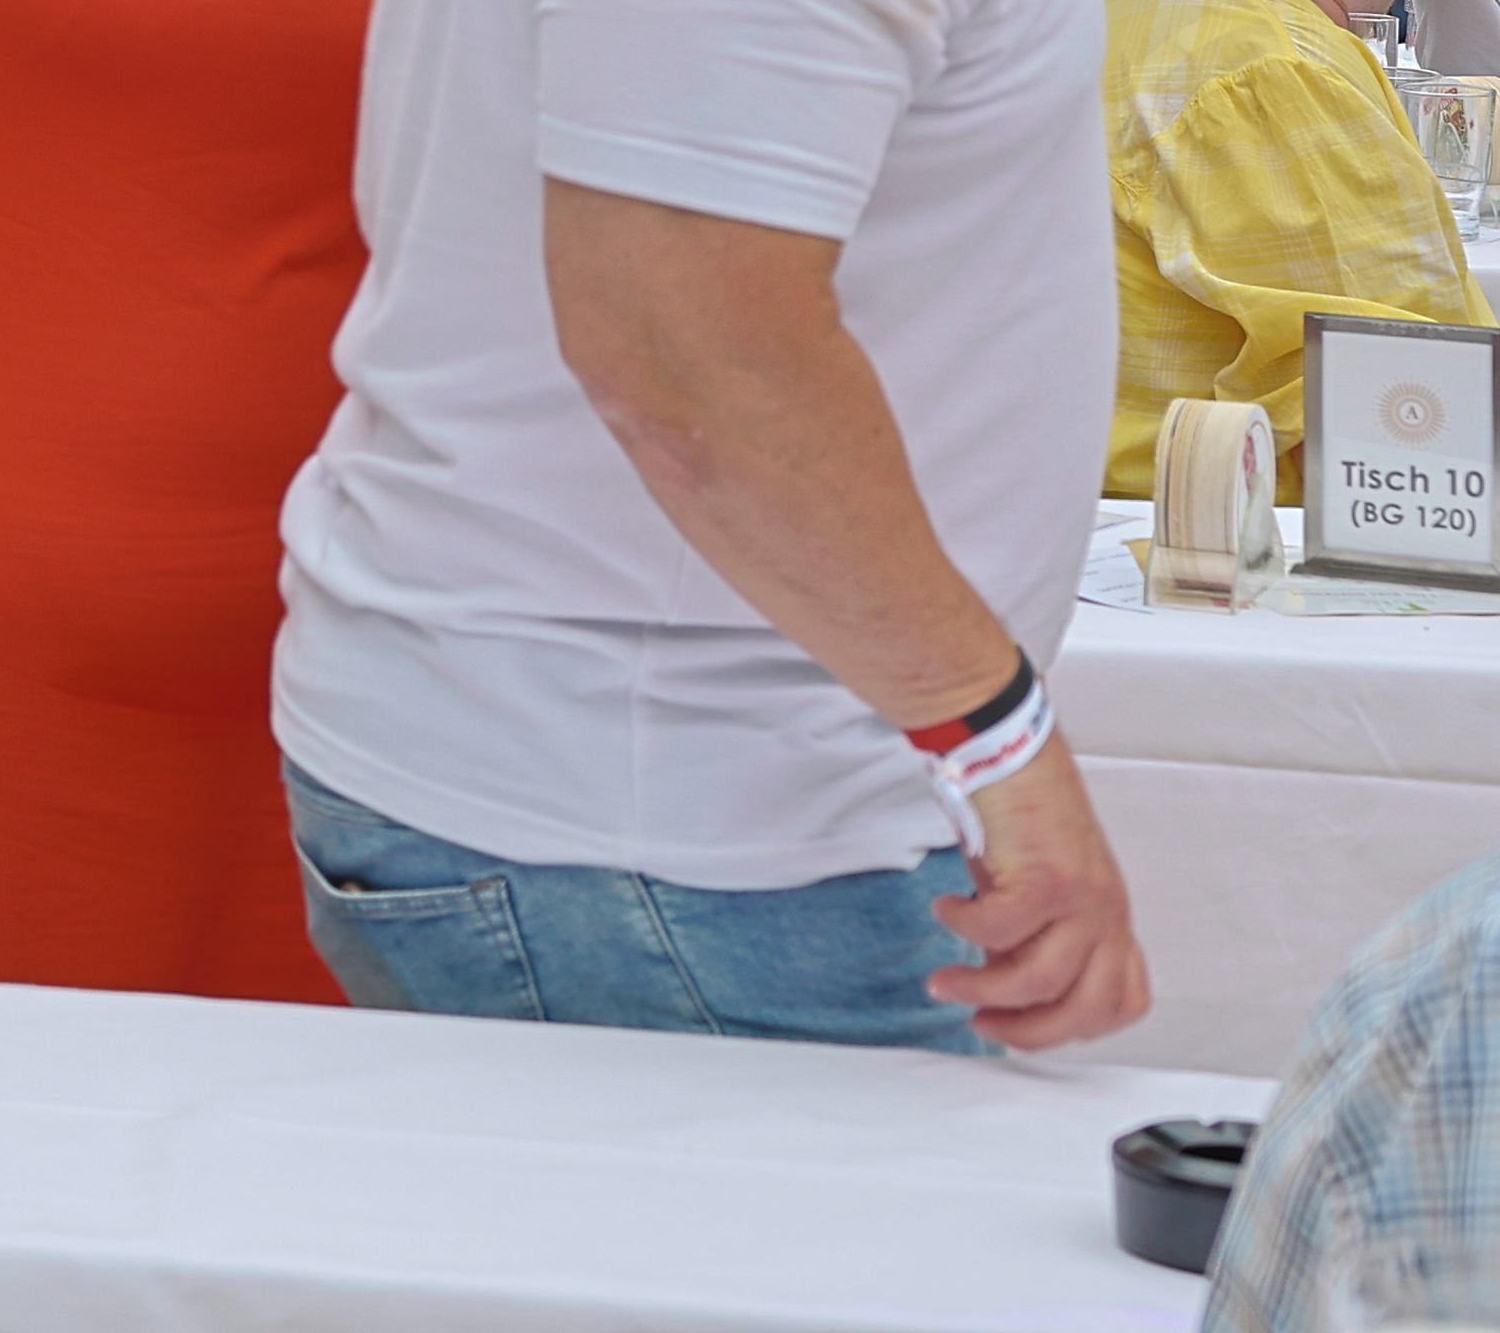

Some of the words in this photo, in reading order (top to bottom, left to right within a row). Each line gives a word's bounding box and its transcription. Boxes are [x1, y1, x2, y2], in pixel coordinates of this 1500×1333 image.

[1341, 460, 1431, 494] Tisch
[1445, 469, 1485, 498] 10
[1351, 499, 1404, 529] (BG
[1417, 506, 1477, 538] 120)
